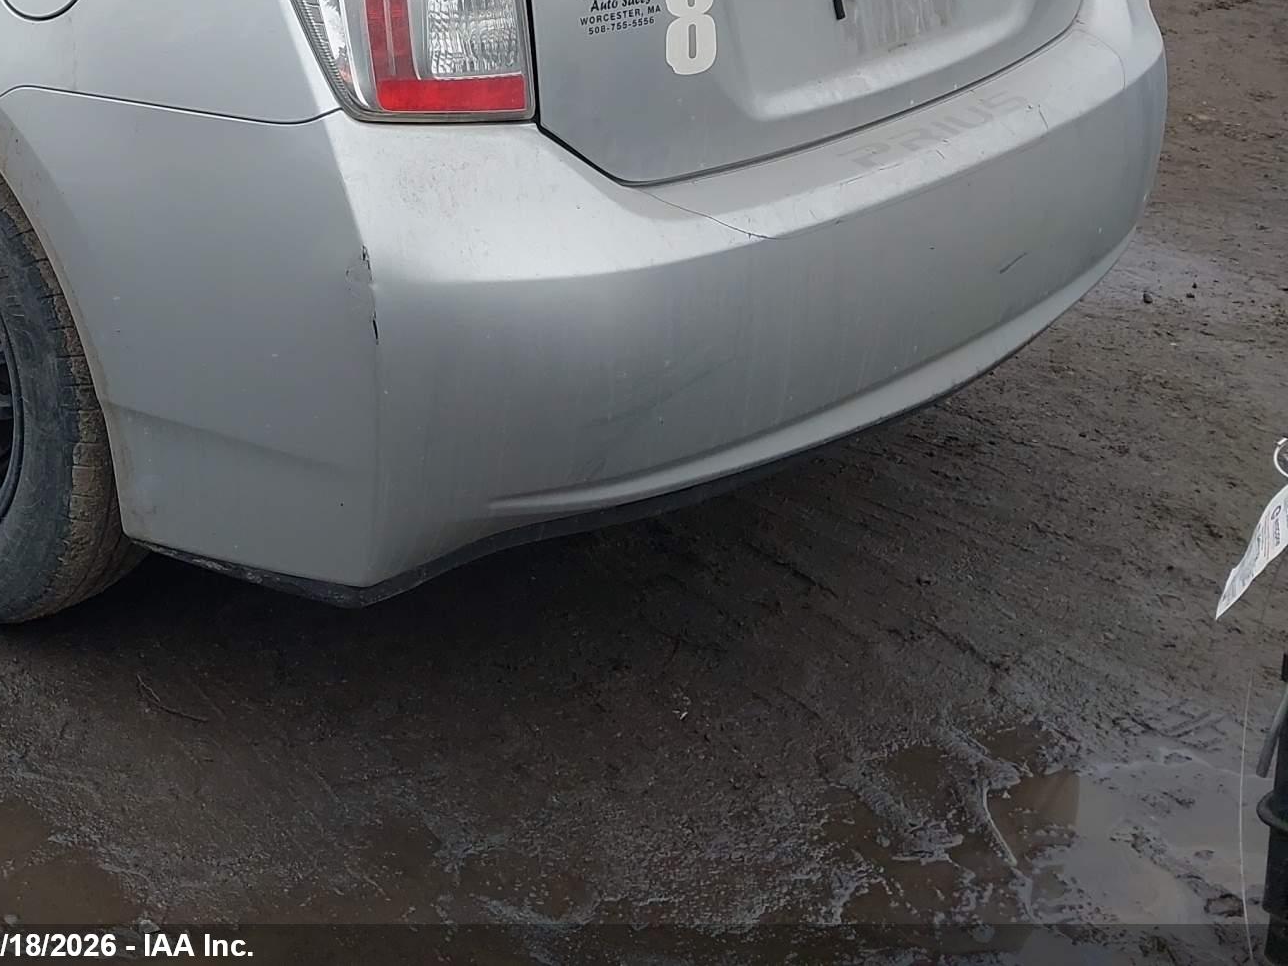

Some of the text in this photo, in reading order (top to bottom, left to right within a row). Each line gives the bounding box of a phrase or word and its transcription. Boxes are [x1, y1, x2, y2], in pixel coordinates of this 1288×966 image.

[580, 4, 661, 26] WORCESTER, MA
[588, 17, 655, 35] 508-755-5556
